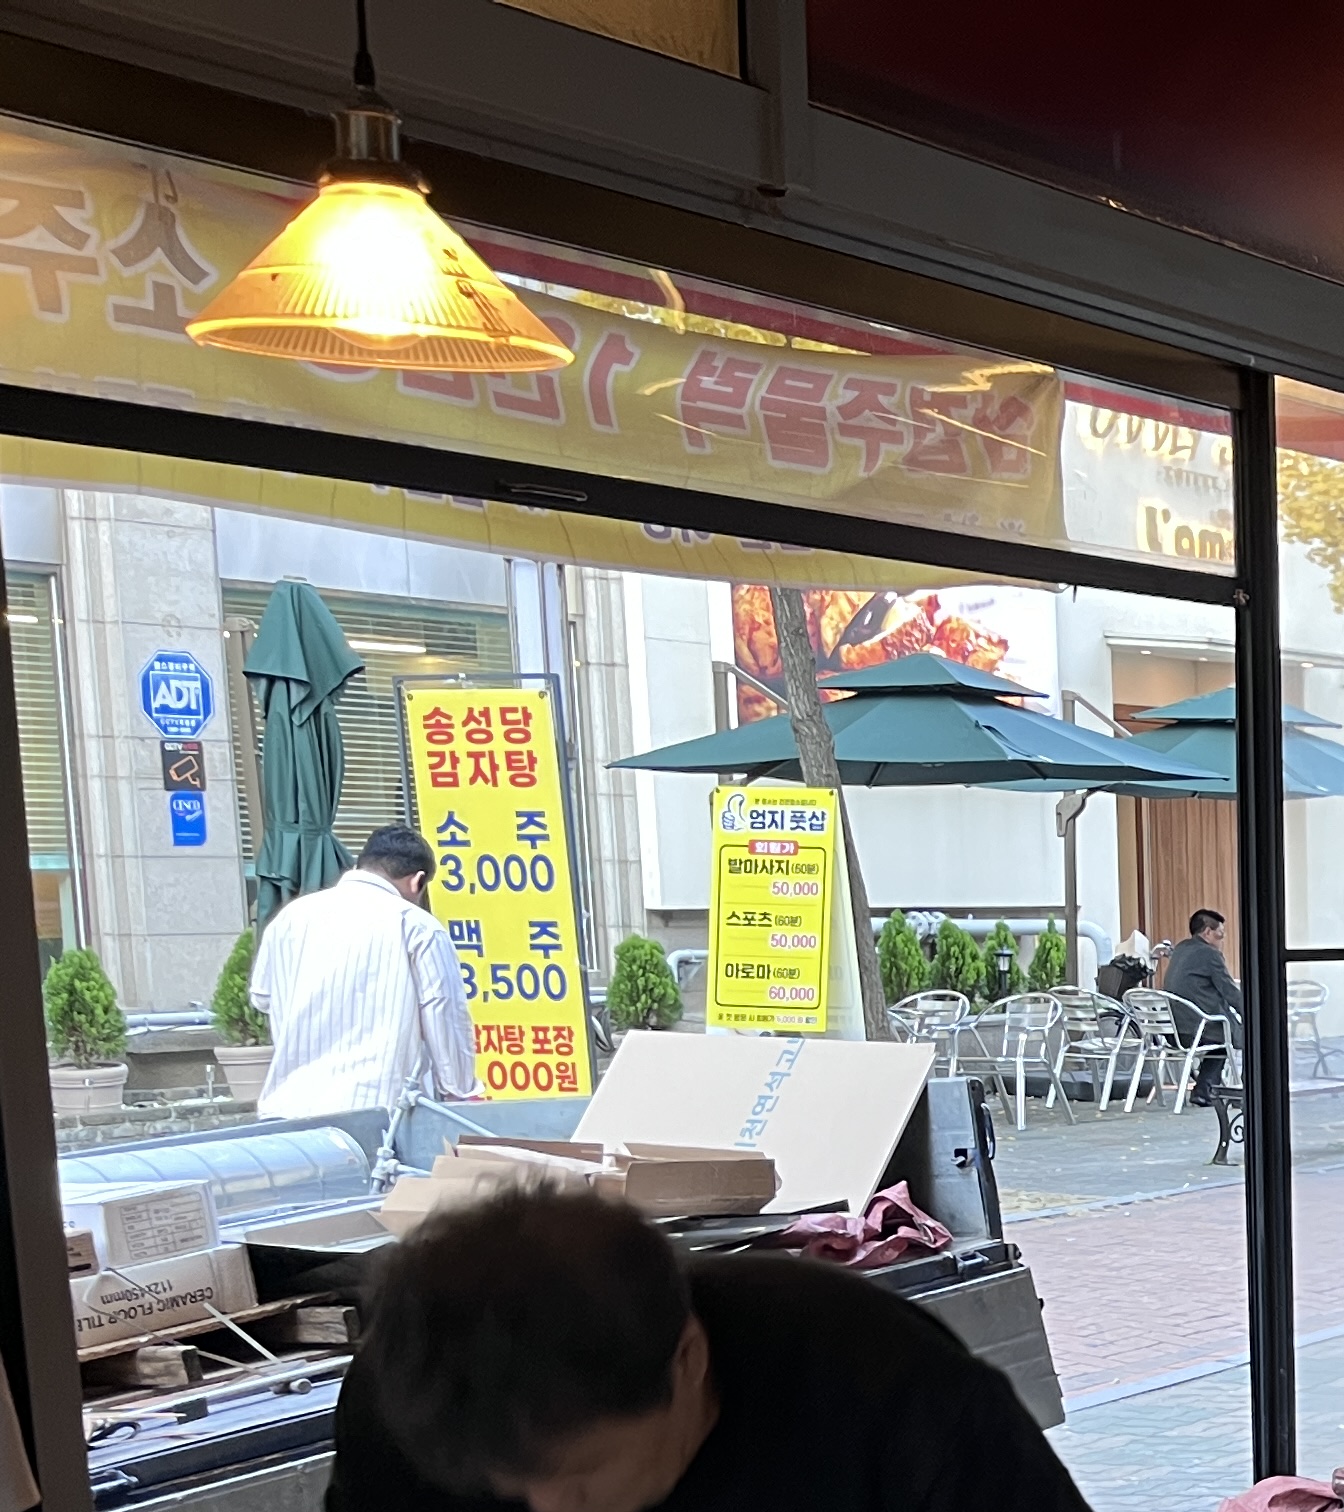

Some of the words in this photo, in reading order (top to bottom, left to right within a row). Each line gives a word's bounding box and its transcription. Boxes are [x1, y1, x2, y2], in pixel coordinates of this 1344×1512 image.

[153, 679, 200, 711] ADT
[421, 705, 533, 746] 송성당
[426, 749, 538, 788] 감자탕
[749, 809, 785, 830] 엄지
[789, 809, 827, 831] 풋샵
[439, 853, 556, 895] 3,000
[727, 857, 790, 876] 발마사지
[771, 881, 819, 898] 50,000
[725, 910, 773, 928] 스포츠
[770, 933, 817, 949] 50,000
[724, 962, 771, 980] 아로마
[460, 962, 568, 1003] 3,500
[768, 985, 815, 1002] 60,000
[530, 1025, 575, 1057] 포장
